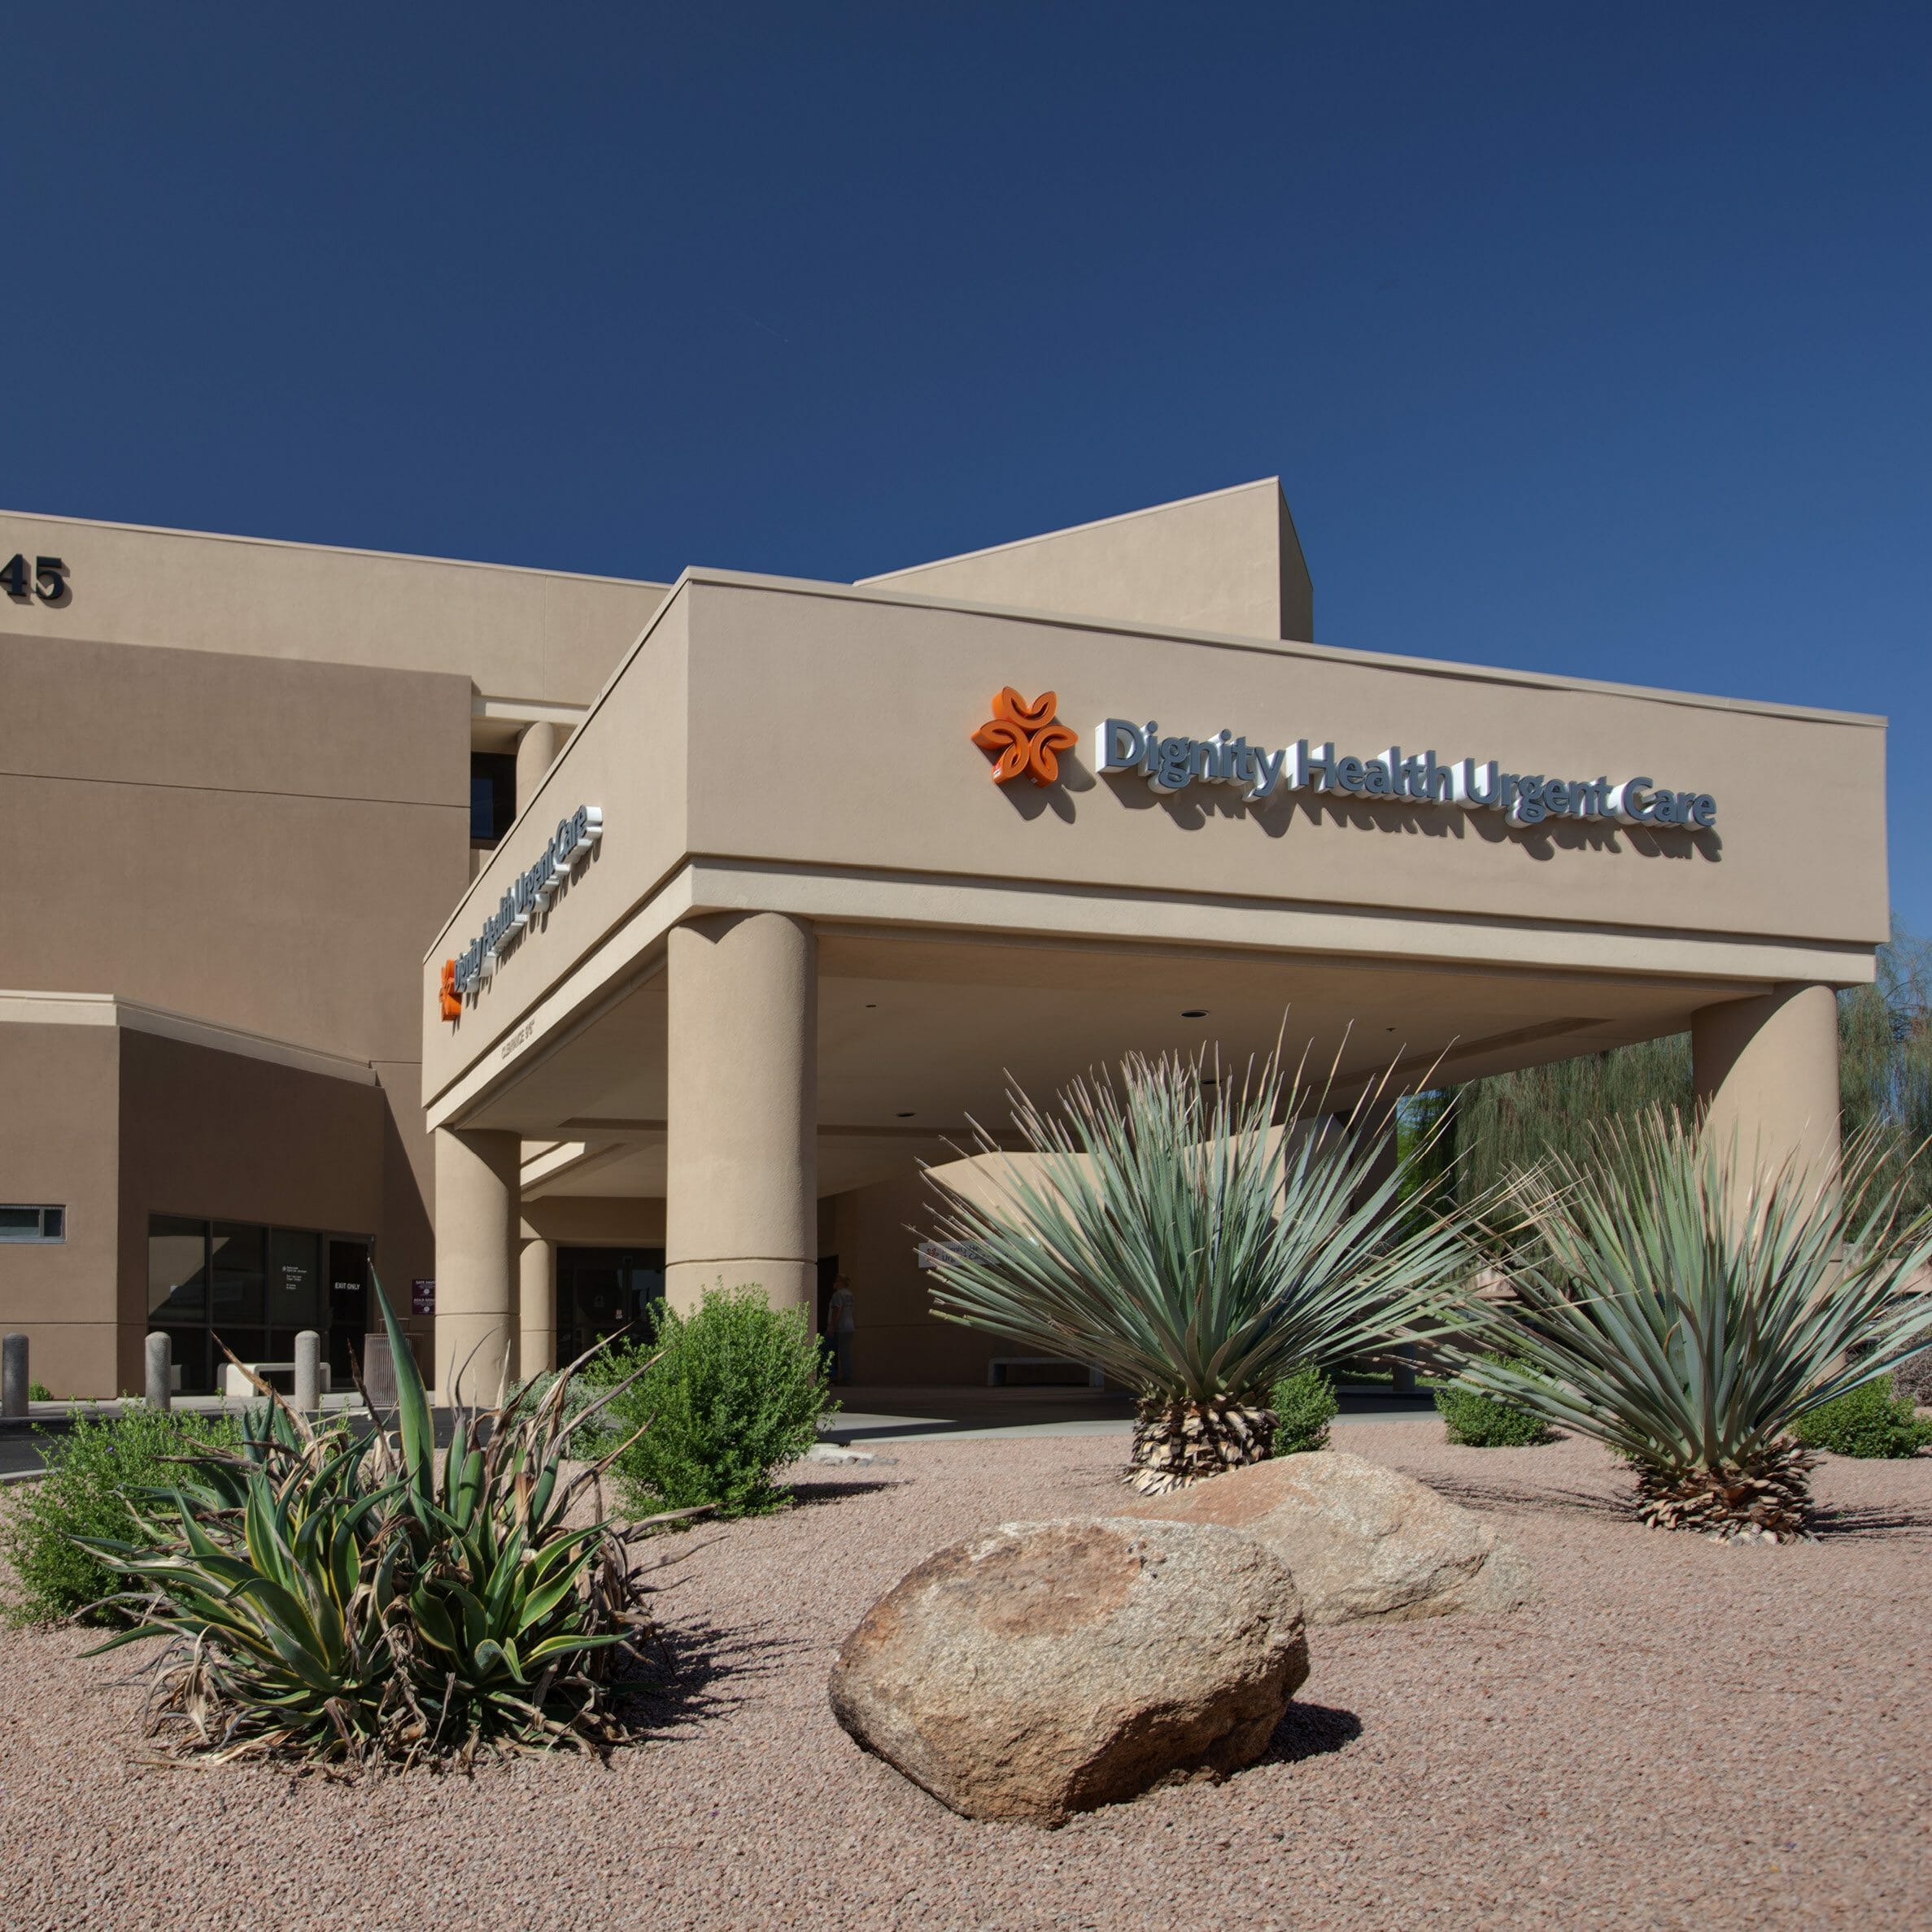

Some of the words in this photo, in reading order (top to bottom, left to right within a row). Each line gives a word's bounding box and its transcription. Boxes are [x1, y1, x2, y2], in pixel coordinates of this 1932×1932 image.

[0, 553, 64, 600] 45
[1102, 717, 1286, 798] Dignity
[1297, 739, 1454, 801] Health
[1463, 757, 1615, 823] Urgent
[1623, 776, 1717, 827] Care
[555, 804, 587, 864] Care
